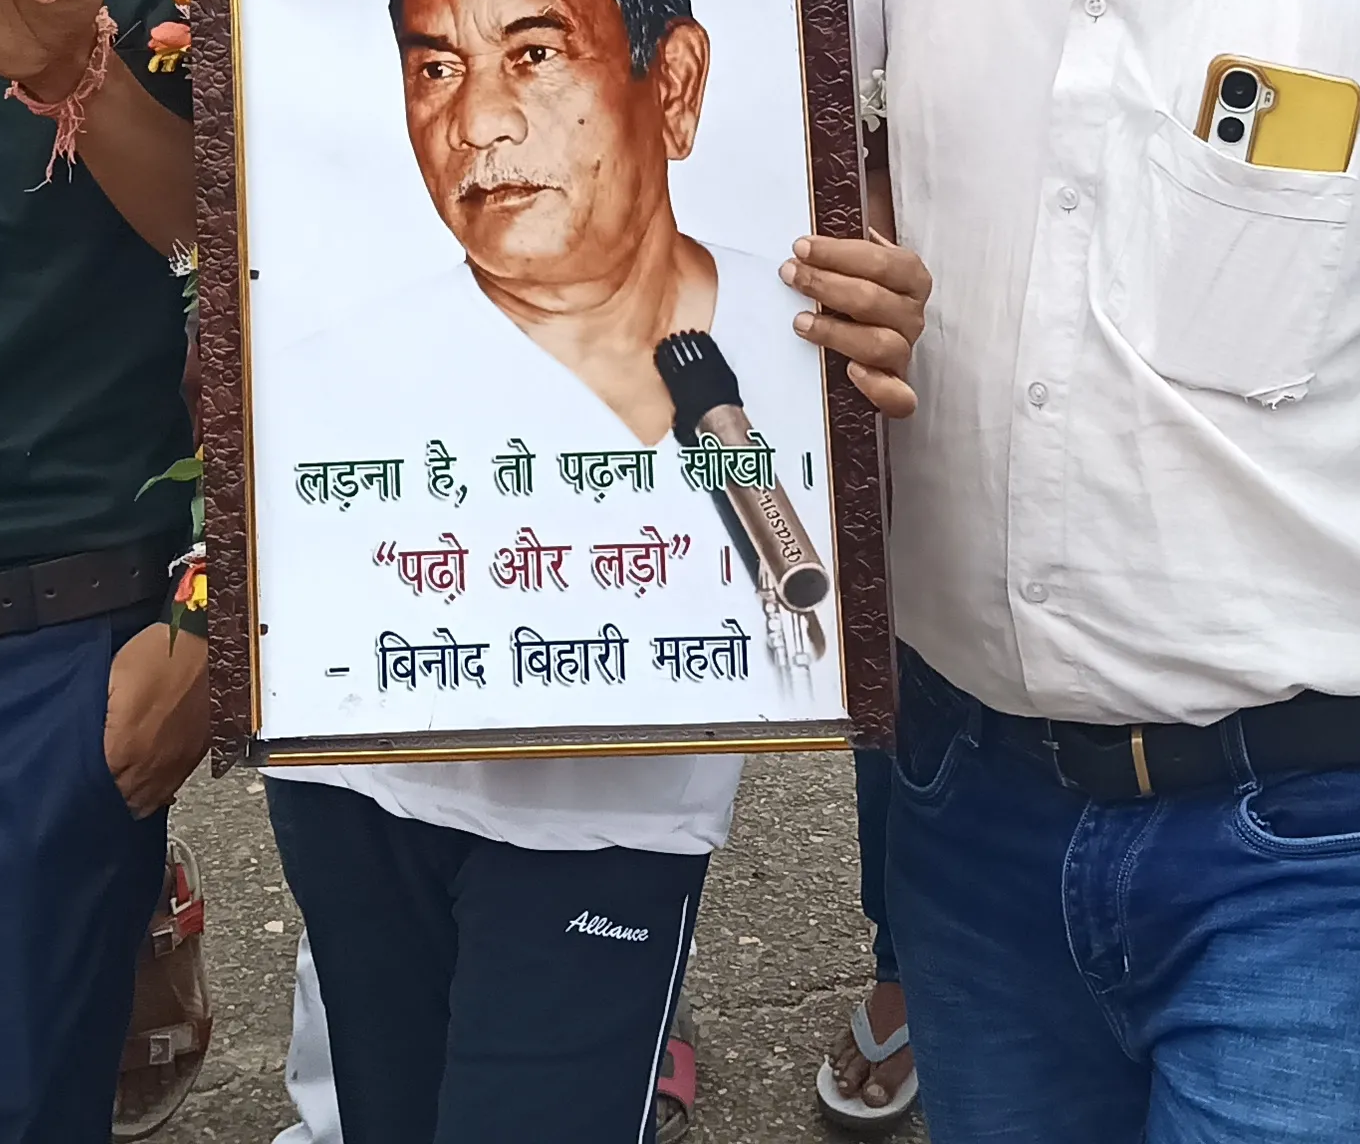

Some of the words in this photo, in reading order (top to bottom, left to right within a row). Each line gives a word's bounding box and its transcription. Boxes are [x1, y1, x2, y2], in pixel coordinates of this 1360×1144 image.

[296, 458, 404, 511] लड़ना
[426, 439, 468, 507] है,
[492, 438, 536, 496] तो
[557, 450, 657, 502] पढ़ना
[678, 431, 777, 492] सीखो
[490, 526, 572, 594] और
[376, 630, 490, 692] बिनोद
[511, 623, 629, 687] बिहारी
[650, 618, 752, 682] महतो
[565, 910, 649, 942] Alliance
